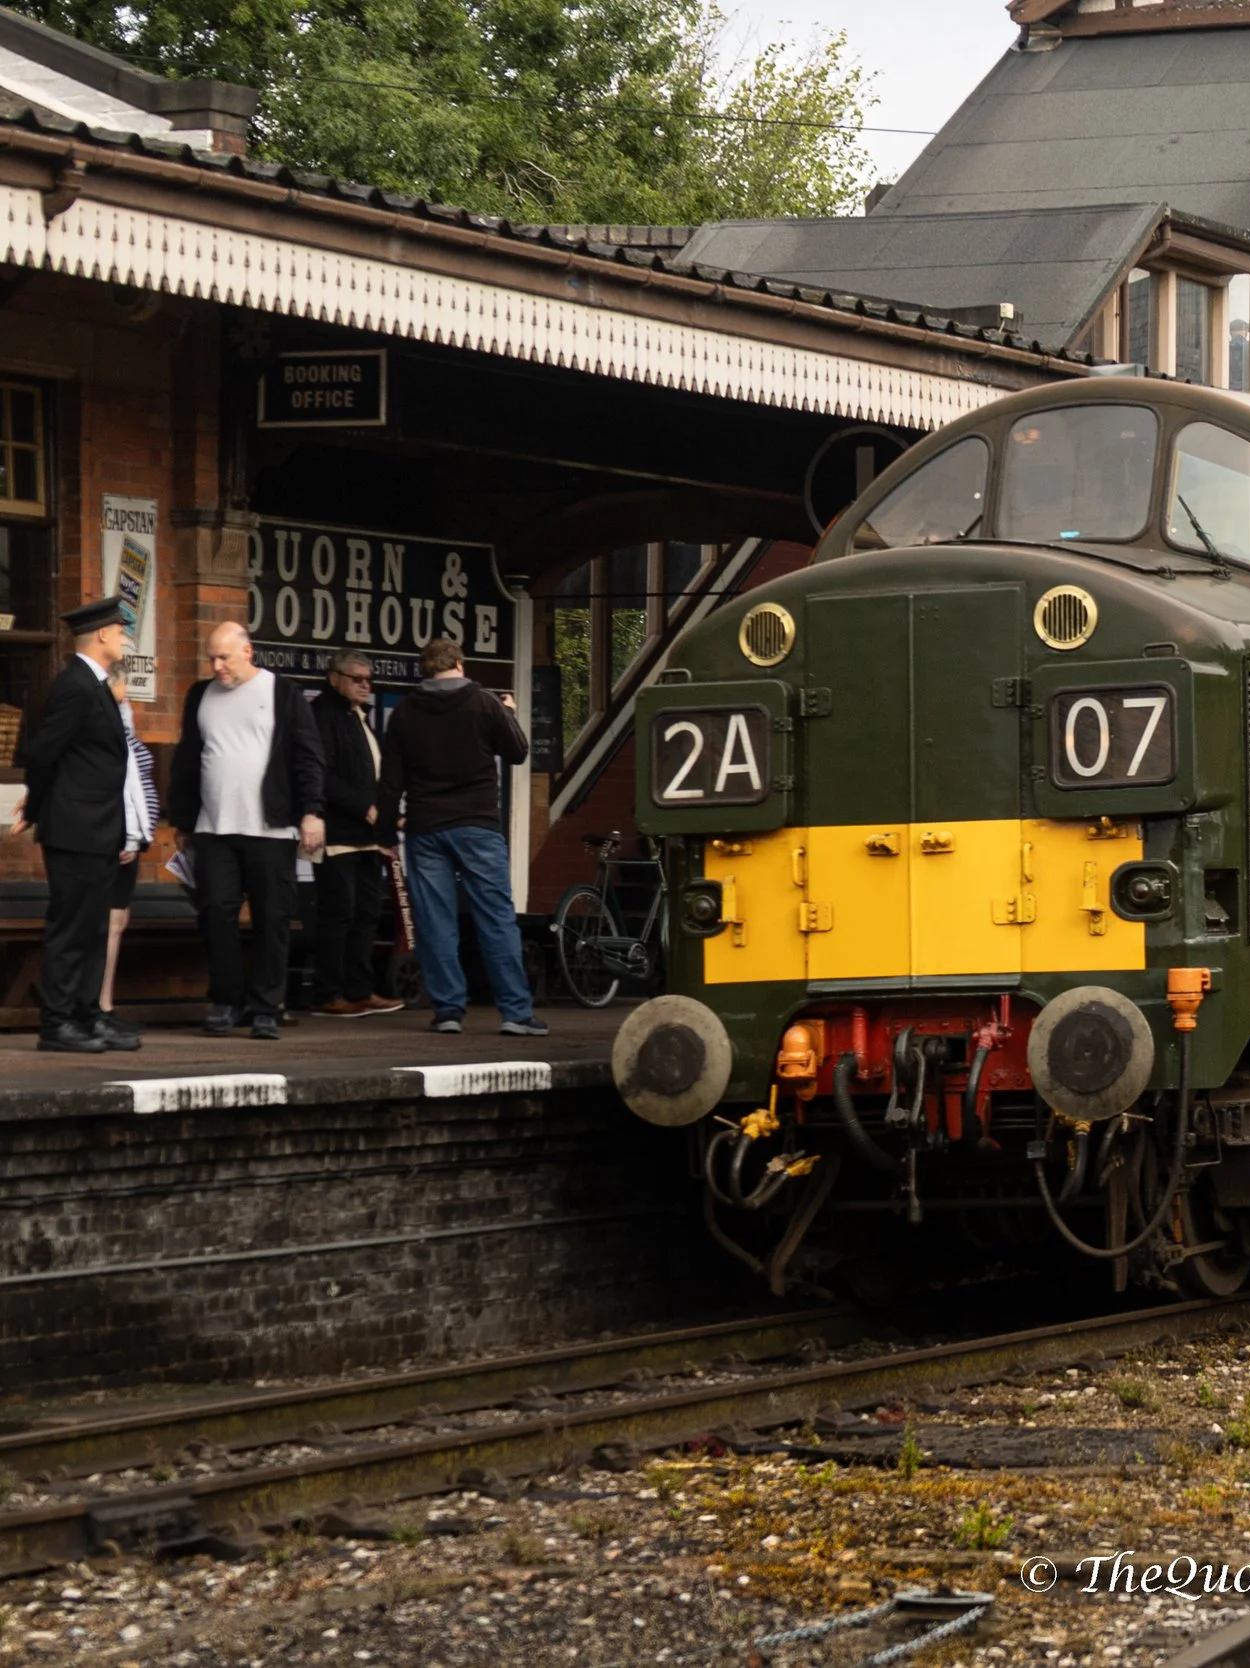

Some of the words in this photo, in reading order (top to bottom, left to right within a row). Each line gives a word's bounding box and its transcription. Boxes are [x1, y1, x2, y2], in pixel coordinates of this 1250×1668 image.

[283, 364, 362, 384] BOOKING
[291, 389, 355, 409] OFFICE
[104, 508, 155, 535] CAPSTAN
[441, 551, 469, 599] &
[249, 583, 498, 654] OODHOUSE
[253, 650, 295, 669] ONDON
[302, 655, 310, 669] &
[1065, 697, 1168, 777] 07
[662, 714, 762, 799] 2A
